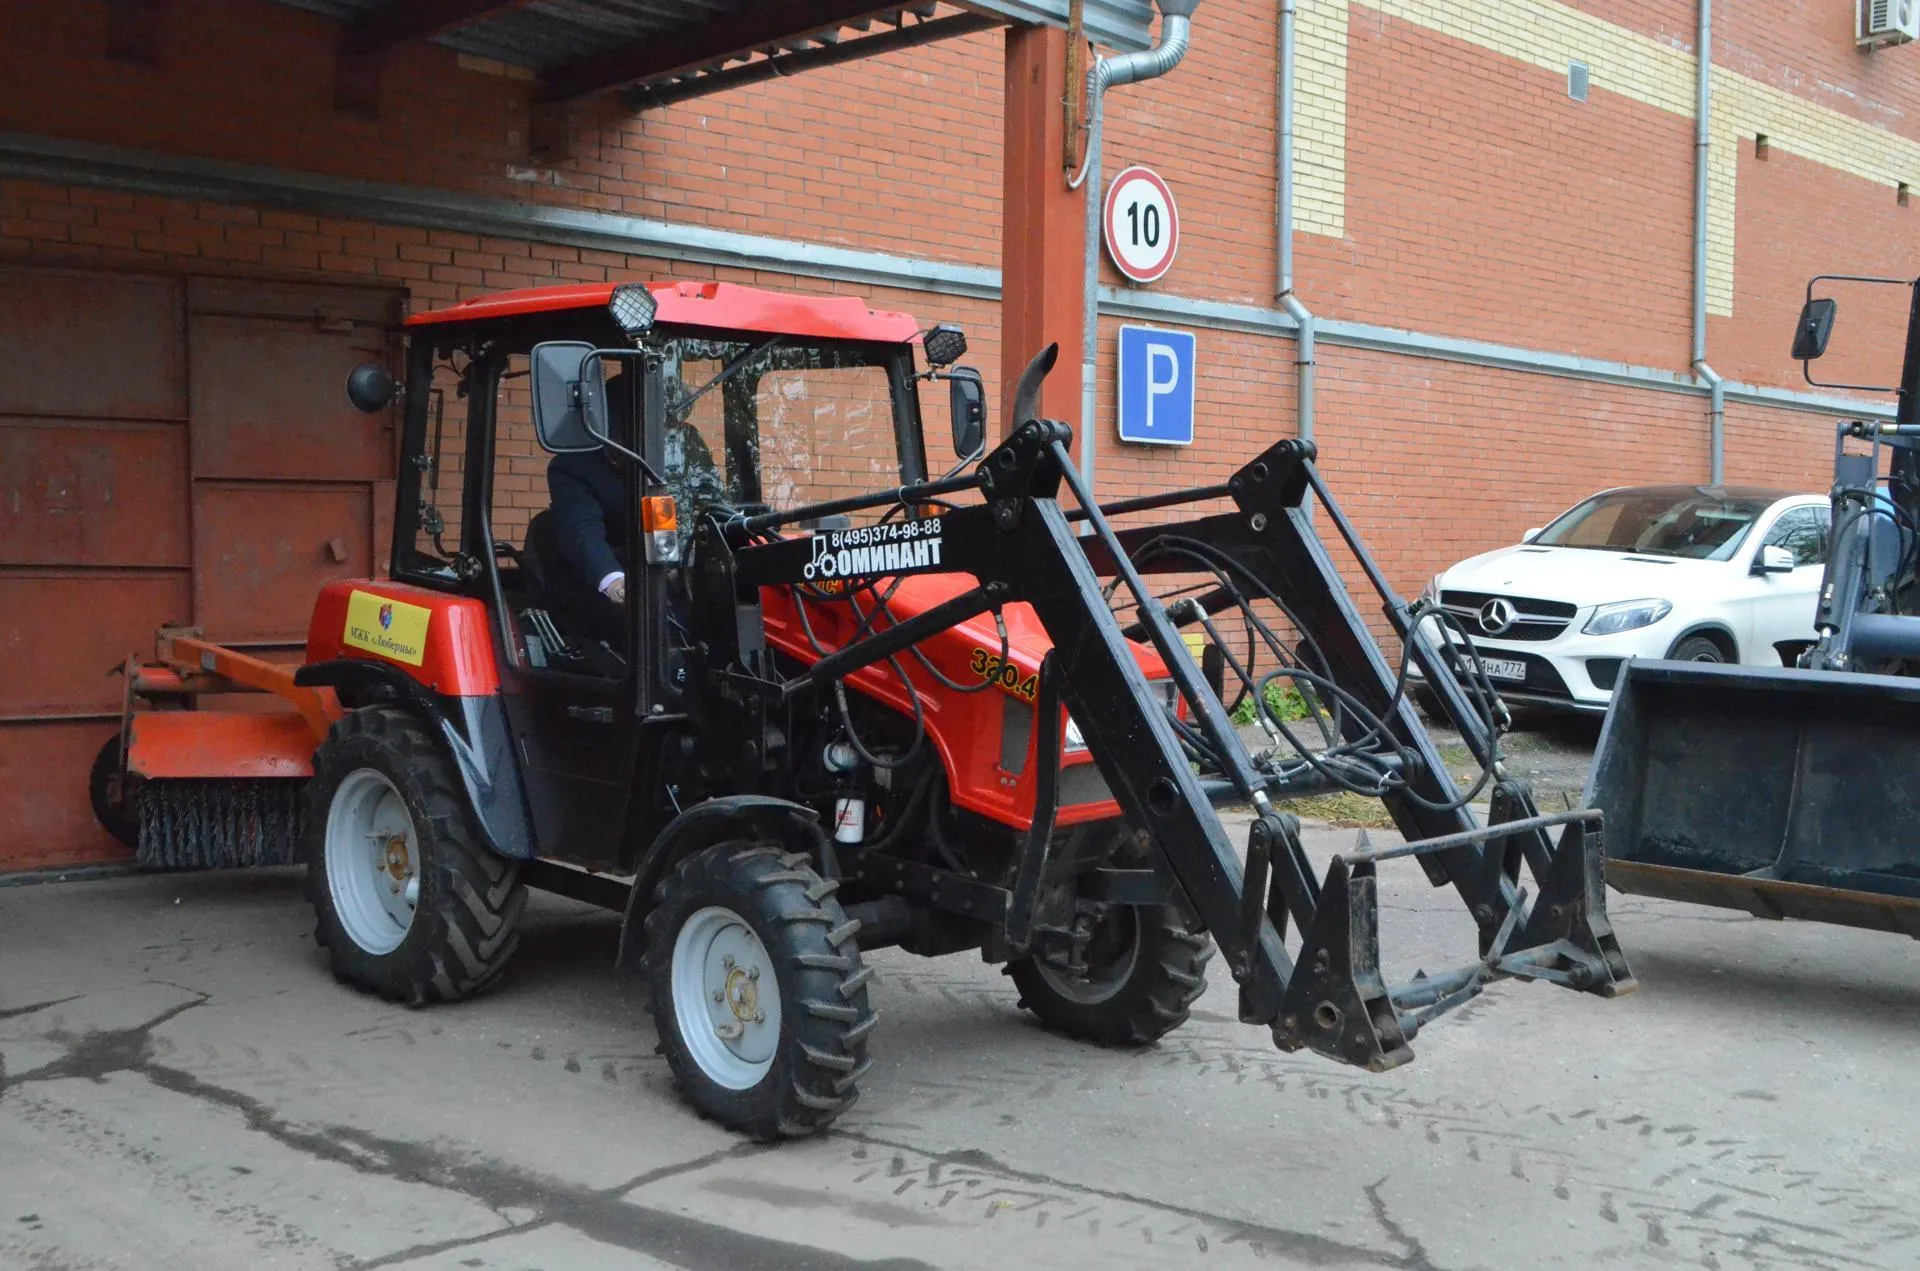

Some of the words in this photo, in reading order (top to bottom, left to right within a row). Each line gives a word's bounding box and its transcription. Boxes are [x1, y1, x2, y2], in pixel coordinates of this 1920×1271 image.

[1127, 201, 1160, 248] 10
[1146, 343, 1179, 427] P
[831, 518, 942, 549] 8(495)374-98-88
[1503, 661, 1522, 673] 777
